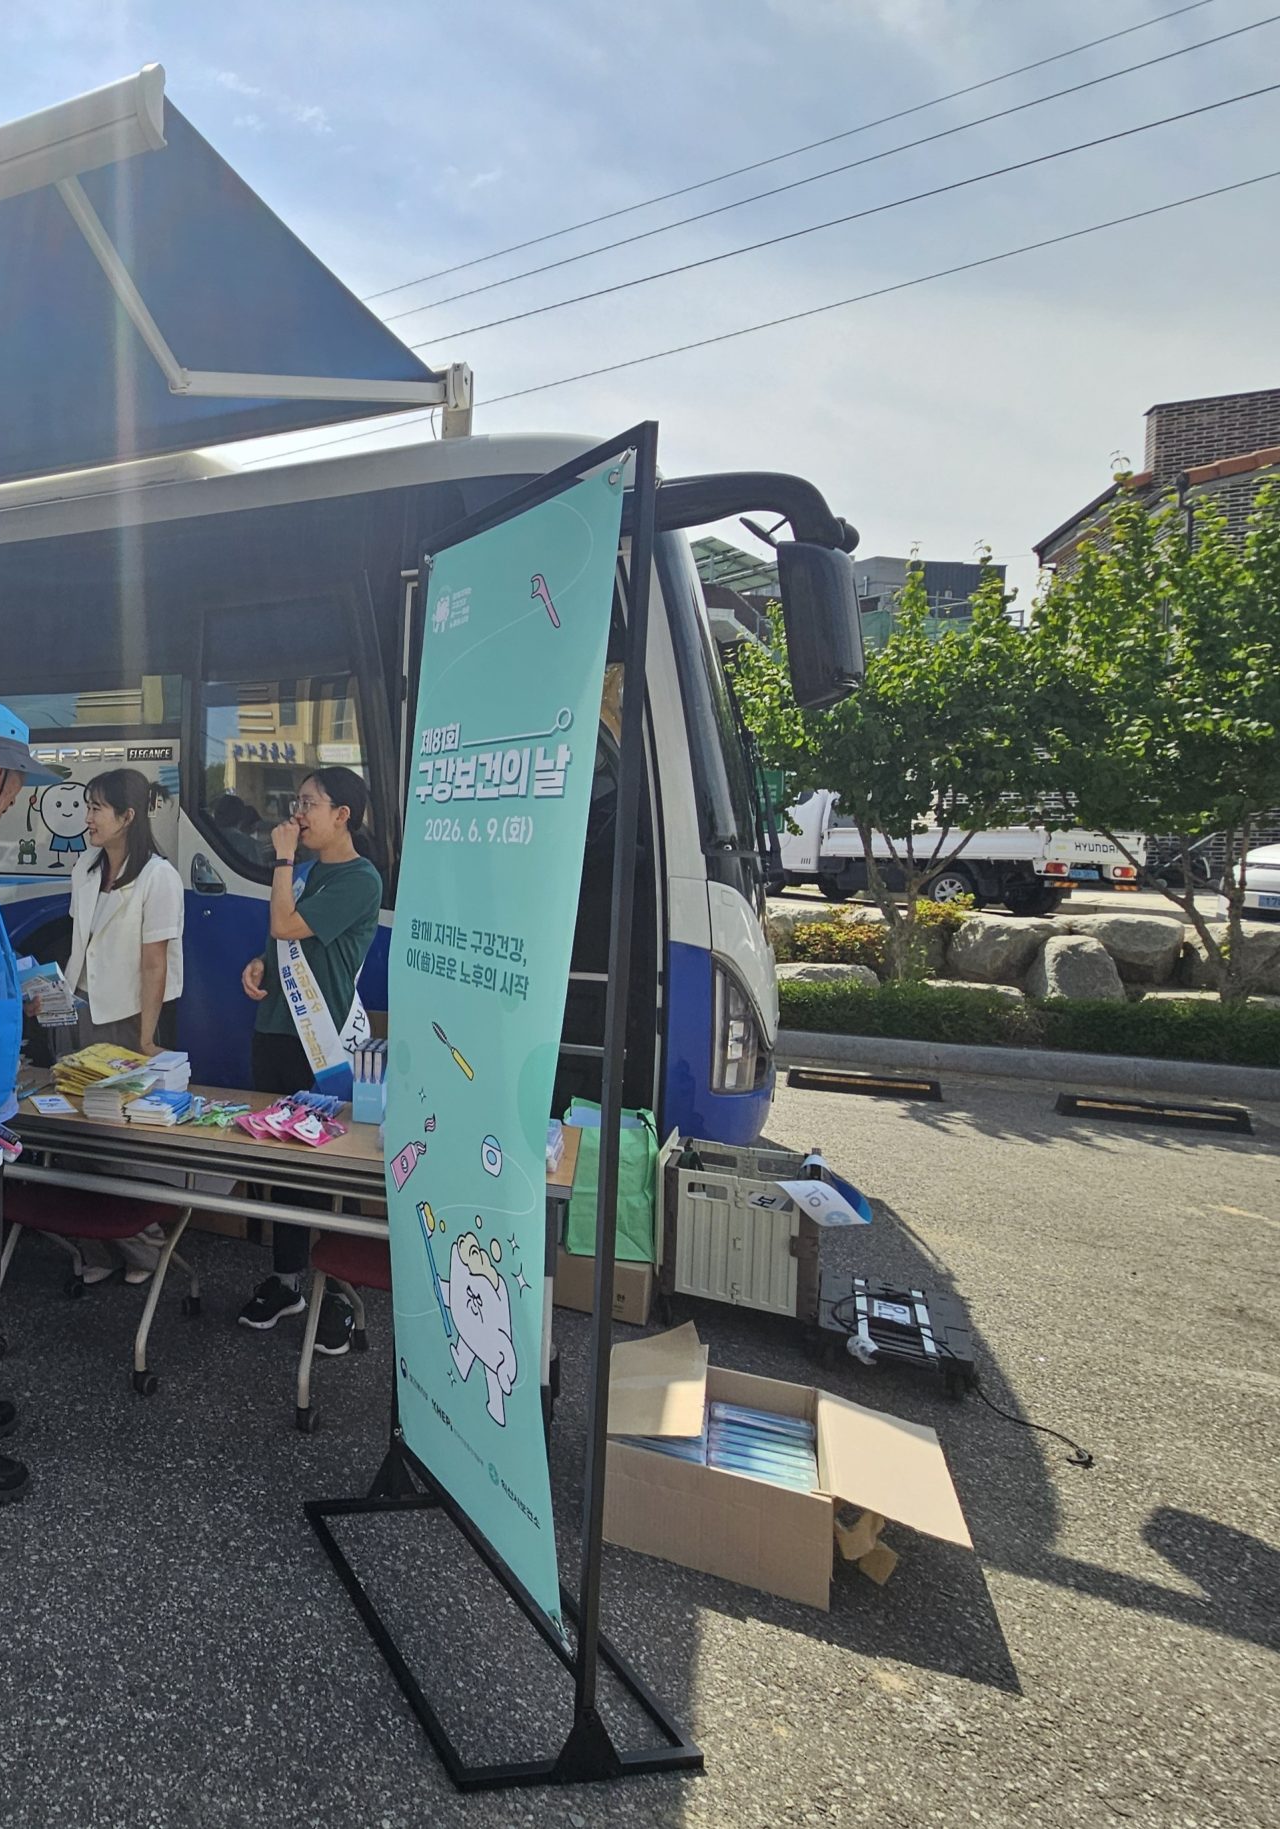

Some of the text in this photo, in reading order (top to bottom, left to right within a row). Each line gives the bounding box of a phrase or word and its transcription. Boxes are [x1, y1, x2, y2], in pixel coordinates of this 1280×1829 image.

[31, 747, 170, 763] ERSE ELEGANCE
[420, 723, 461, 755] 제81회
[416, 743, 570, 803] 구강보건의 날
[424, 817, 464, 842] 2026.
[468, 818, 482, 843] 6.
[411, 918, 527, 967] 함께 지키는 구강건강,
[281, 965, 308, 1016] 함께하는
[459, 961, 497, 992] 노후의
[499, 971, 530, 1001] 시작
[343, 1008, 366, 1055] 건소
